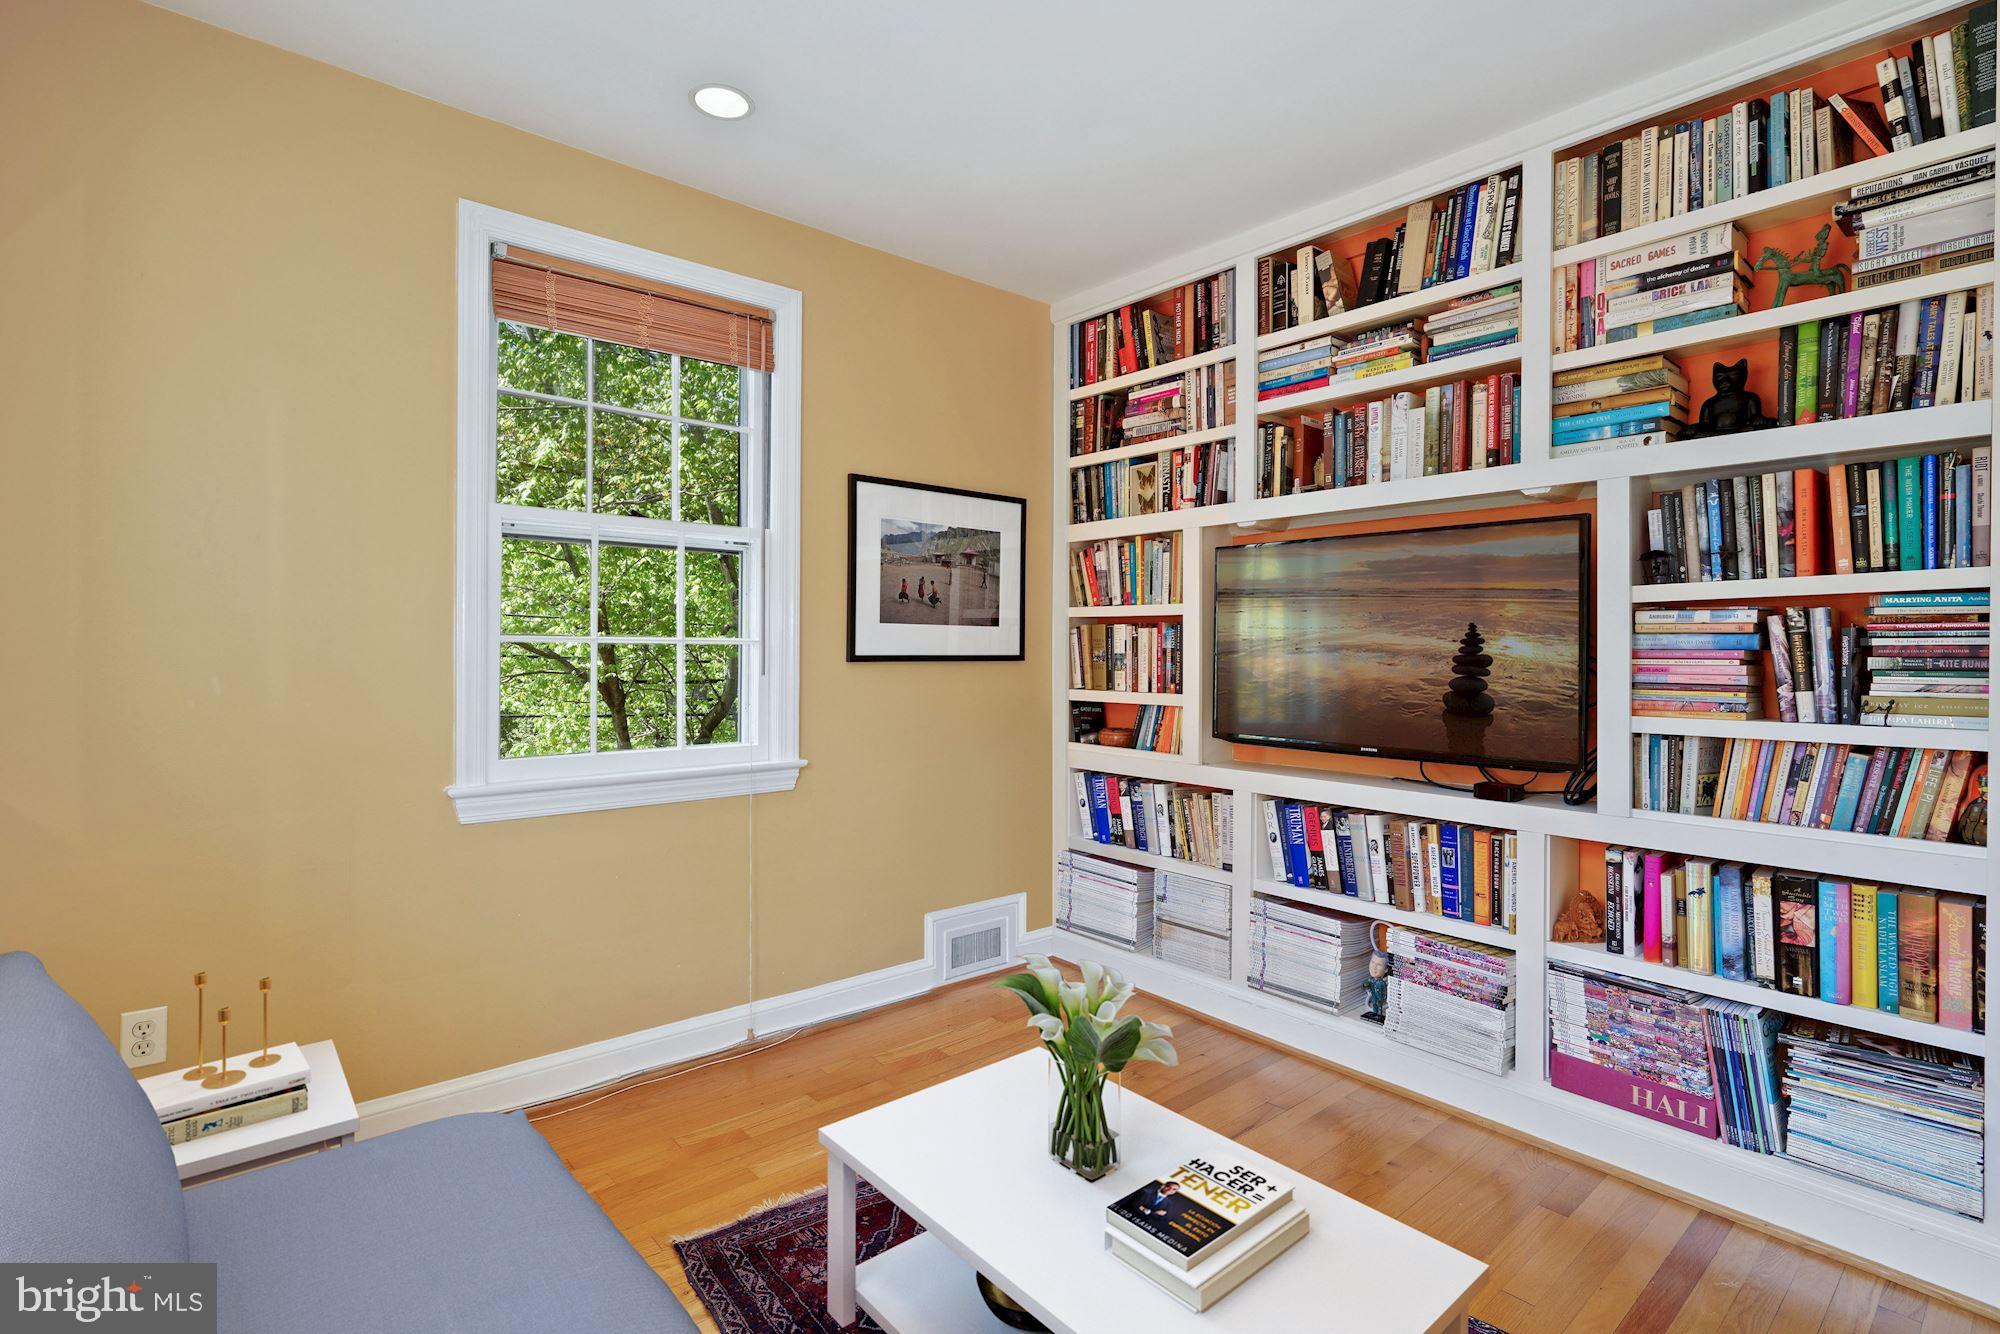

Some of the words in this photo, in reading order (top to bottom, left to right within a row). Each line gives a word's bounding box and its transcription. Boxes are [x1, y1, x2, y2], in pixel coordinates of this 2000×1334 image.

[1487, 177, 1497, 194] LIAR'S
[1856, 178, 1903, 196] REPUTATIONS
[1912, 172, 1928, 182] JUAN
[1928, 164, 1953, 176] GABRIEL
[1466, 184, 1478, 218] Showdown
[1486, 195, 1495, 214] POKER
[1506, 196, 1516, 206] THE
[1502, 207, 1514, 231] WORLD'S
[1462, 224, 1472, 242] Gucci
[1500, 231, 1512, 252] BANKER
[1700, 230, 1709, 255] CHANDRA
[1866, 228, 1876, 257] REBECCA
[1876, 226, 1889, 255] WEST
[1460, 242, 1470, 260] Gulch
[1688, 236, 1697, 256] VIKRAM
[1610, 254, 1642, 271] SACRED
[1648, 246, 1676, 262] GAMES
[1858, 258, 1886, 272] SUGAR
[1891, 250, 1921, 264] STREET
[1260, 262, 1270, 298] MAUGHAM
[1656, 270, 1683, 281] alchemy
[1690, 263, 1710, 272] desire
[1860, 271, 1891, 287] PALACE
[1894, 264, 1920, 280] WALK
[1652, 284, 1687, 302] BRICK
[1928, 300, 1939, 320] FAIRY
[1852, 314, 1862, 334] Gifted
[1926, 320, 1936, 340] TALES
[1925, 341, 1935, 350] AT
[1924, 351, 1934, 369] FIFTY
[1370, 407, 1379, 426] INDIA
[1558, 420, 1571, 428] THE
[1266, 424, 1274, 452] INDIA
[1162, 455, 1170, 494] DYNASTY
[1905, 465, 1913, 478] THE
[1975, 456, 1988, 472] RIOT
[1905, 479, 1913, 496] WISH
[1905, 497, 1914, 518] MAKER
[1940, 659, 1960, 668] KITE
[1911, 717, 1949, 726] LAHIRI
[1876, 746, 1886, 758] THE
[1924, 768, 1940, 786] LIFE
[1096, 778, 1106, 809] TRUMAN
[1920, 793, 1934, 803] PI
[1136, 804, 1146, 841] LINDBERGH
[1290, 808, 1304, 844] TRUMAN
[1308, 812, 1318, 847] GENIUS
[1430, 846, 1438, 868] AMERICA
[1492, 840, 1500, 858] BLACK
[1317, 856, 1326, 878] JAMES
[1344, 838, 1356, 884] LINDBERGH
[1410, 852, 1420, 888] SUPERPOWER
[1394, 861, 1406, 887] CENTURY
[1432, 876, 1440, 894] WORLD
[1746, 906, 1754, 936] HAROUN
[1888, 911, 1896, 928] THE
[1878, 918, 1886, 956] NADEEM
[1888, 932, 1897, 968] WASTED
[1878, 958, 1887, 987] ASLAM
[1948, 960, 1962, 997] THRONE
[1630, 1084, 1708, 1128] HALI
[1188, 1157, 1255, 1198] HACER
[1228, 1164, 1267, 1187] SER
[1168, 1166, 1252, 1214] TENER
[1110, 1204, 1131, 1218] ELIDO
[1132, 1216, 1156, 1235] ISAIAS
[1157, 1229, 1188, 1253] MEDINA
